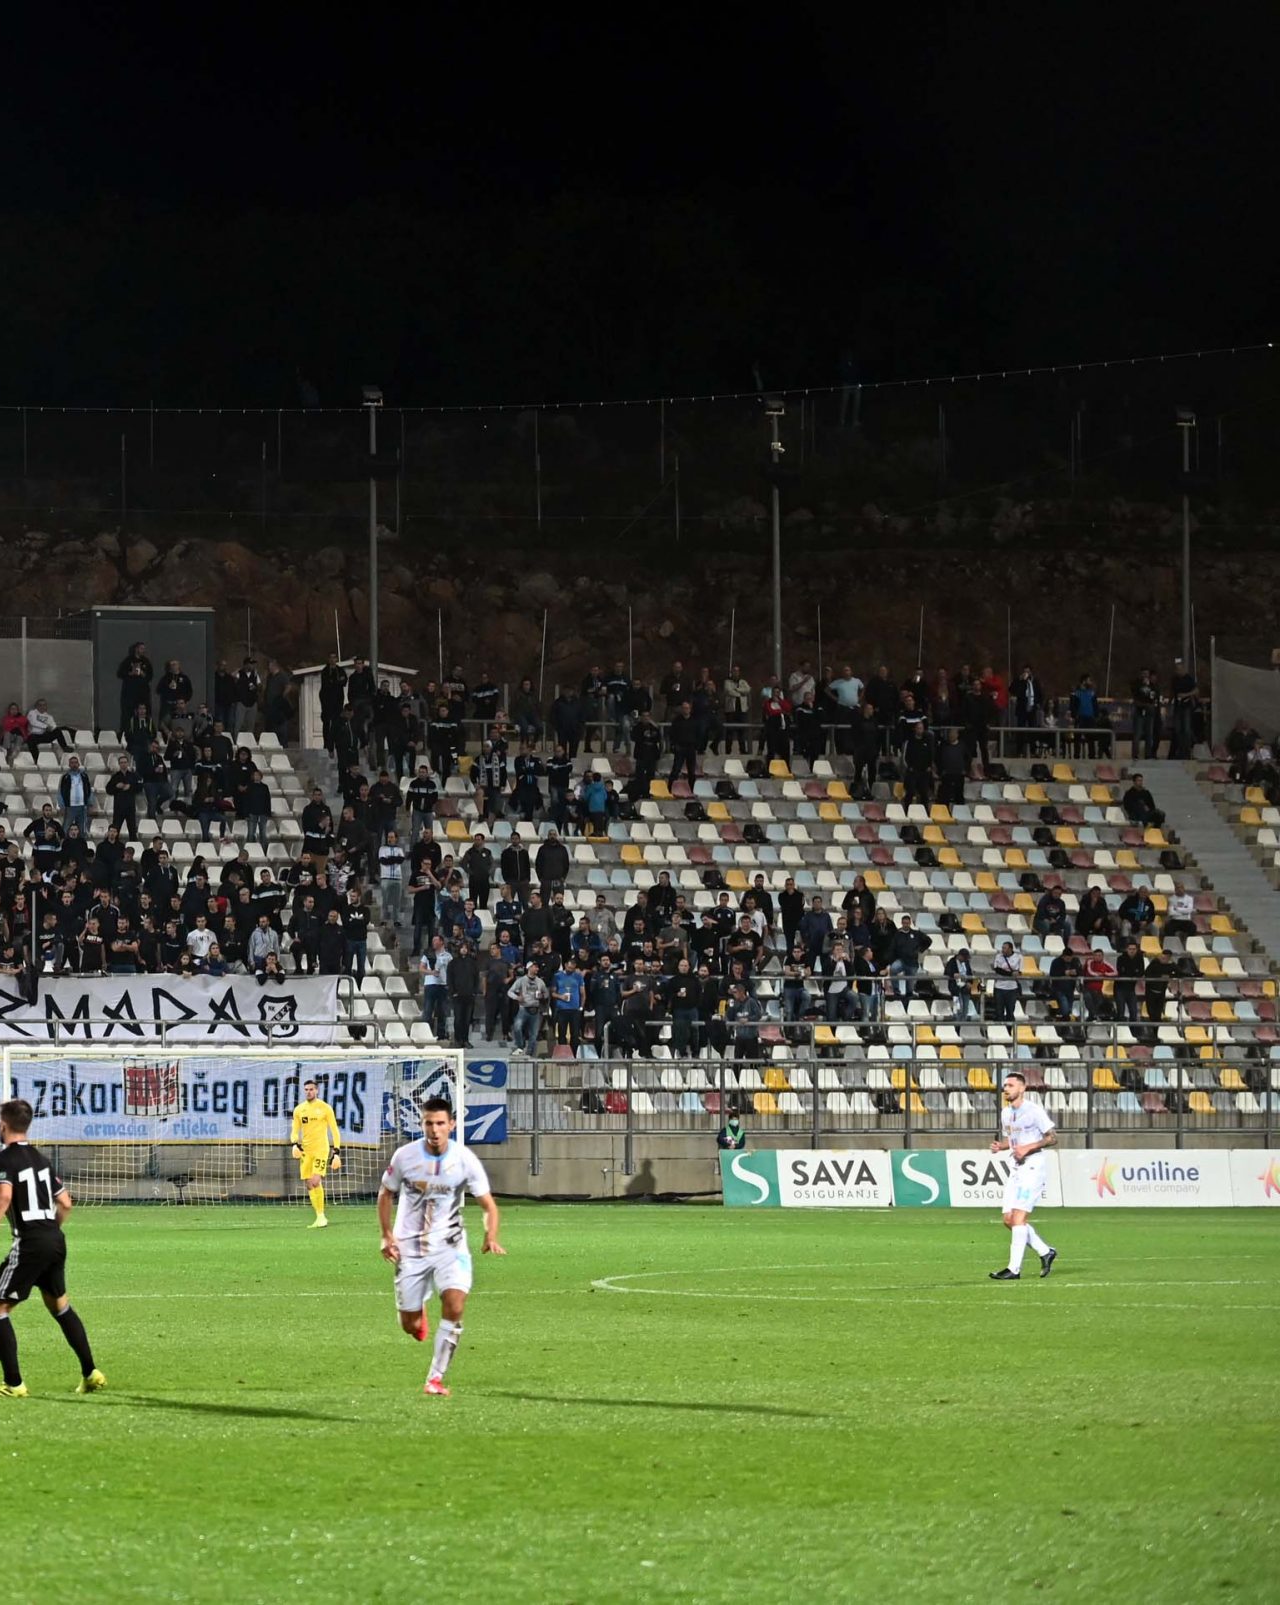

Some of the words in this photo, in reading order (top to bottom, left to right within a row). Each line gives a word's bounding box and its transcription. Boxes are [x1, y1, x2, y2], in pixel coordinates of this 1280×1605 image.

[791, 1160, 878, 1186] SAVA
[1122, 1160, 1200, 1181] uniline
[18, 1167, 57, 1221] 11
[793, 1189, 879, 1199] OSIGURANJE
[1123, 1184, 1151, 1193] travel
[1154, 1184, 1201, 1195] company
